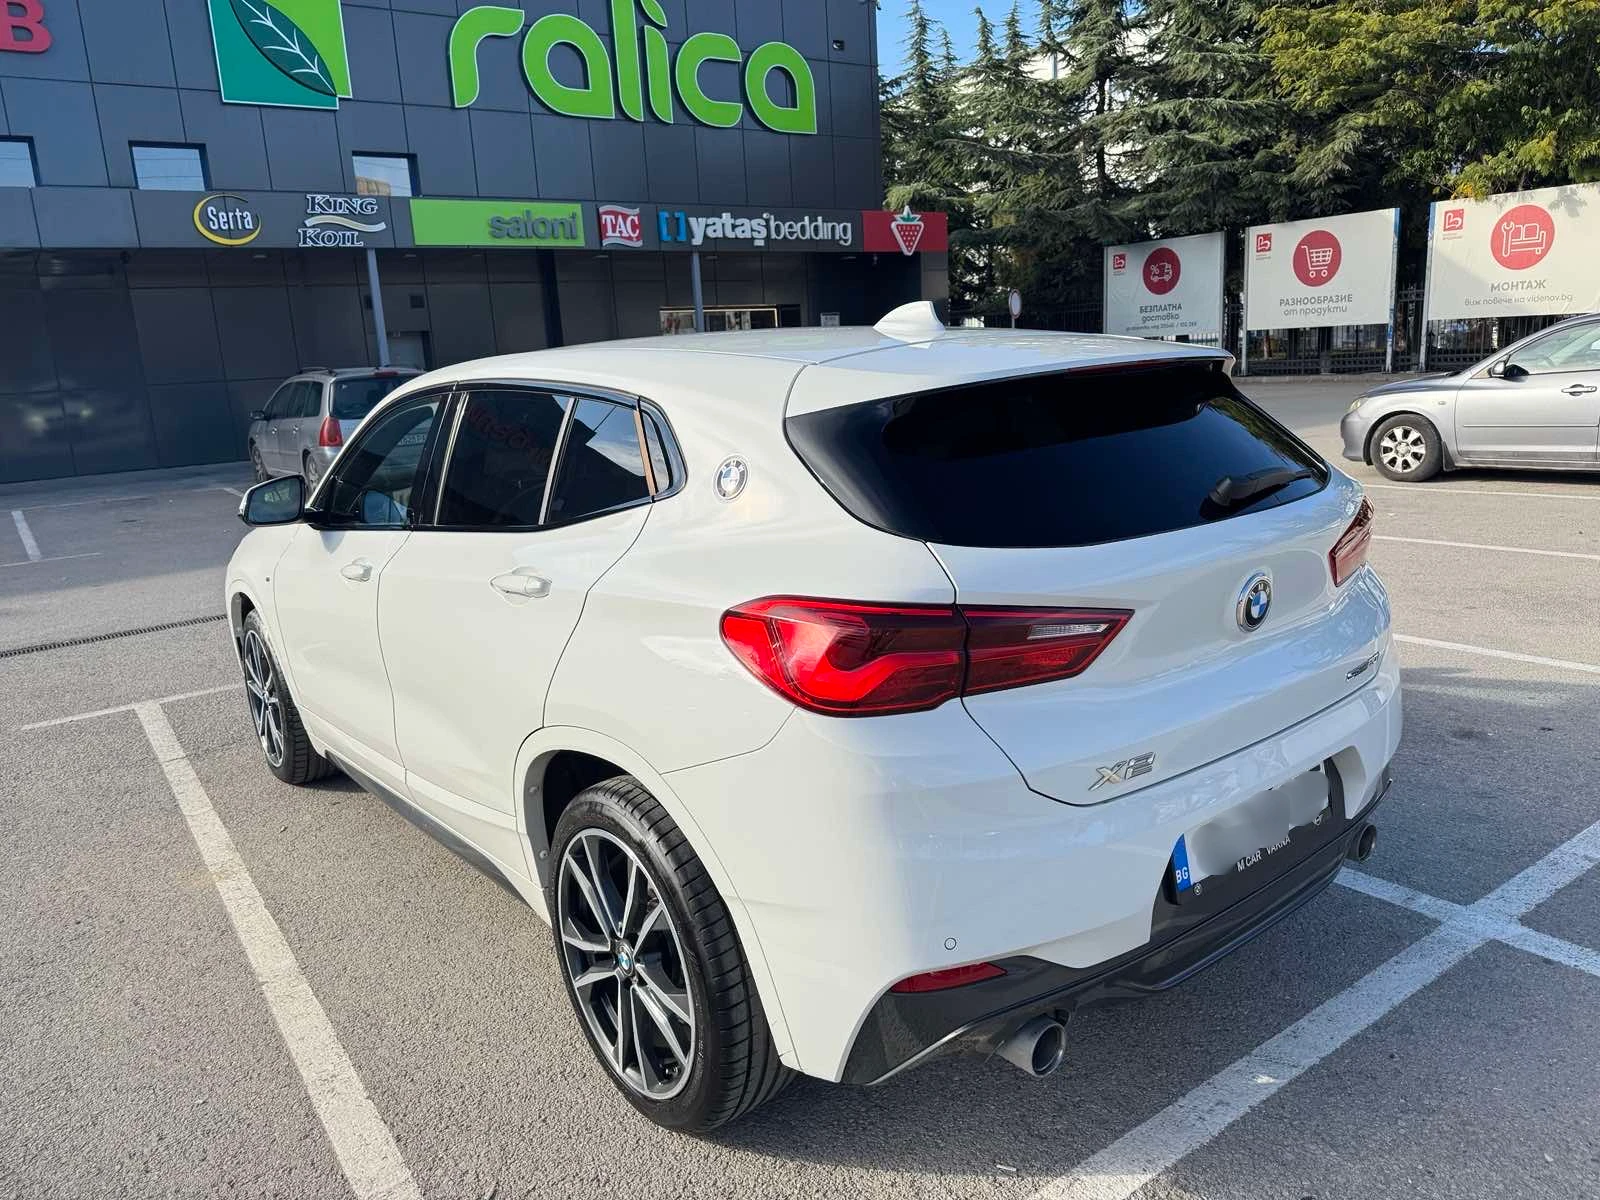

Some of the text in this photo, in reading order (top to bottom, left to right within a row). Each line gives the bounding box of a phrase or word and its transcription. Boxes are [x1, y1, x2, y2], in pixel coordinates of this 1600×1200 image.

[449, 0, 818, 135] ralica
[306, 193, 378, 215] KING
[207, 205, 254, 231] Serta
[488, 208, 578, 240] saloni
[298, 227, 364, 247] KOIL
[769, 214, 852, 246] bedding
[1490, 279, 1547, 293] МОНТАЖ
[1139, 303, 1183, 314] БЕЗПЛАТНА
[1279, 293, 1353, 306] РАЗНООБРАЗИЕ
[1299, 305, 1348, 317] продукти
[1088, 752, 1156, 791] X2
[1236, 859, 1245, 872] M
[1245, 850, 1262, 866] CAR
[1175, 866, 1189, 883] BG
